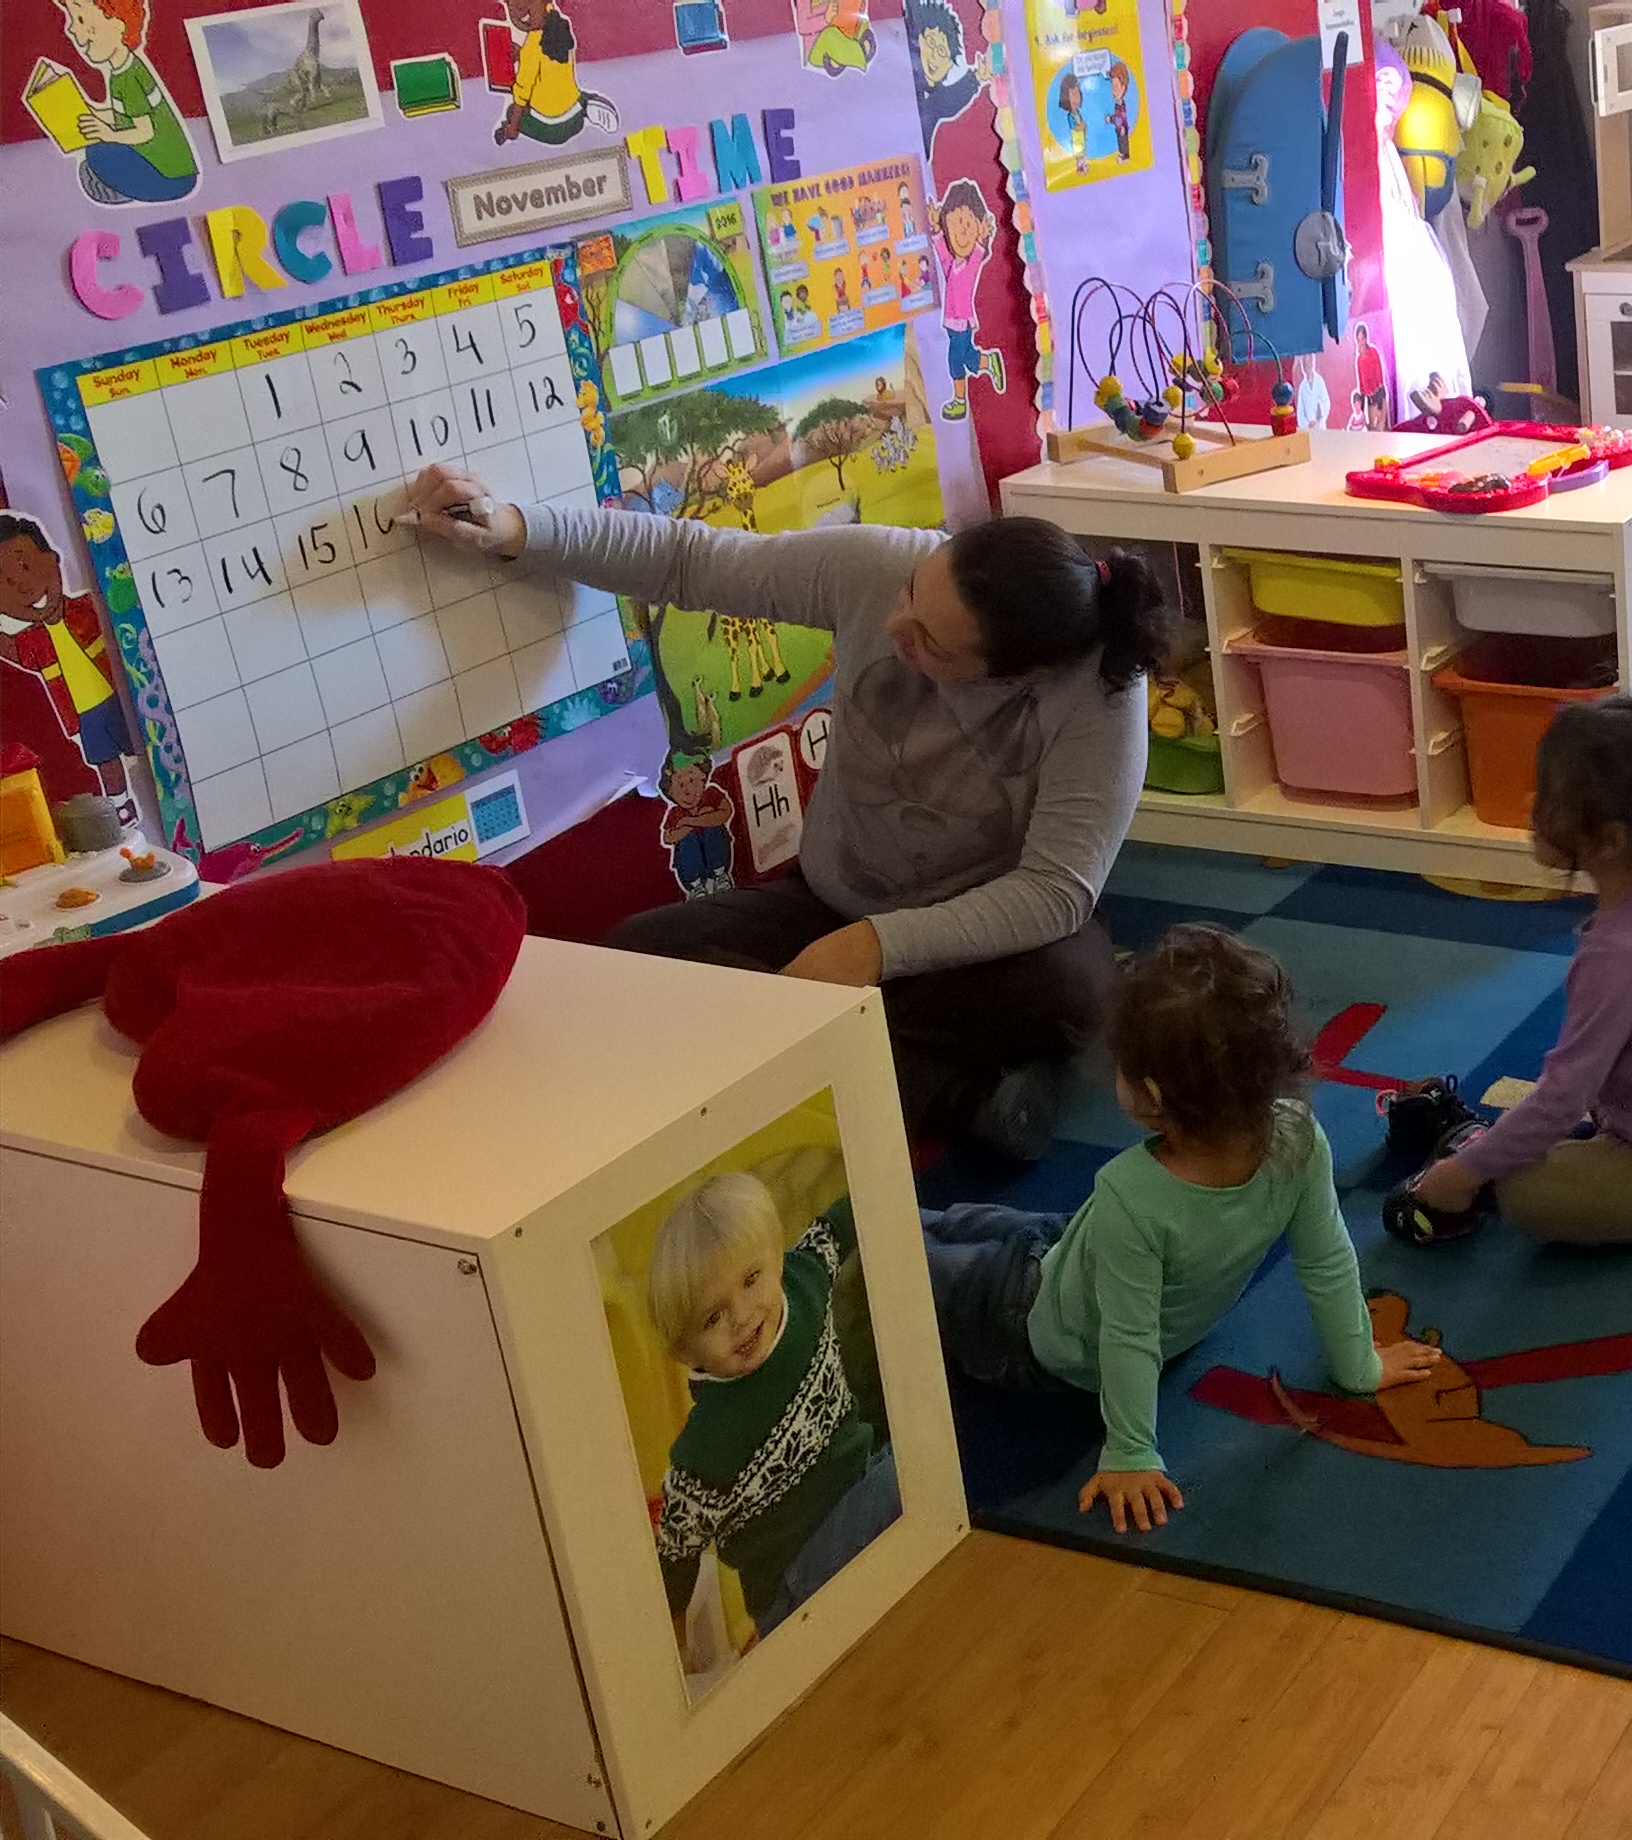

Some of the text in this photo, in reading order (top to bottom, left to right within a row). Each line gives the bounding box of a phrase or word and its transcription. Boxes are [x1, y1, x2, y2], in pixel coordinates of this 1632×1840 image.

[68, 108, 802, 320] CIRCLE TIME
[472, 174, 607, 221] November
[715, 212, 738, 230] 2016
[771, 190, 791, 207] WE
[791, 182, 822, 204] HAVE
[824, 175, 855, 196] GOOD
[93, 265, 544, 388] Sunday Monday Tuesday Wednesday Thursday Friday Saturday
[265, 303, 536, 419] 1 2 3 4 5
[137, 375, 565, 535] 6 7 8 9 10 11 12
[151, 568, 193, 609] 13
[220, 546, 272, 595] 14
[297, 522, 336, 571] 15
[806, 719, 828, 761] H
[752, 783, 790, 828] Hh
